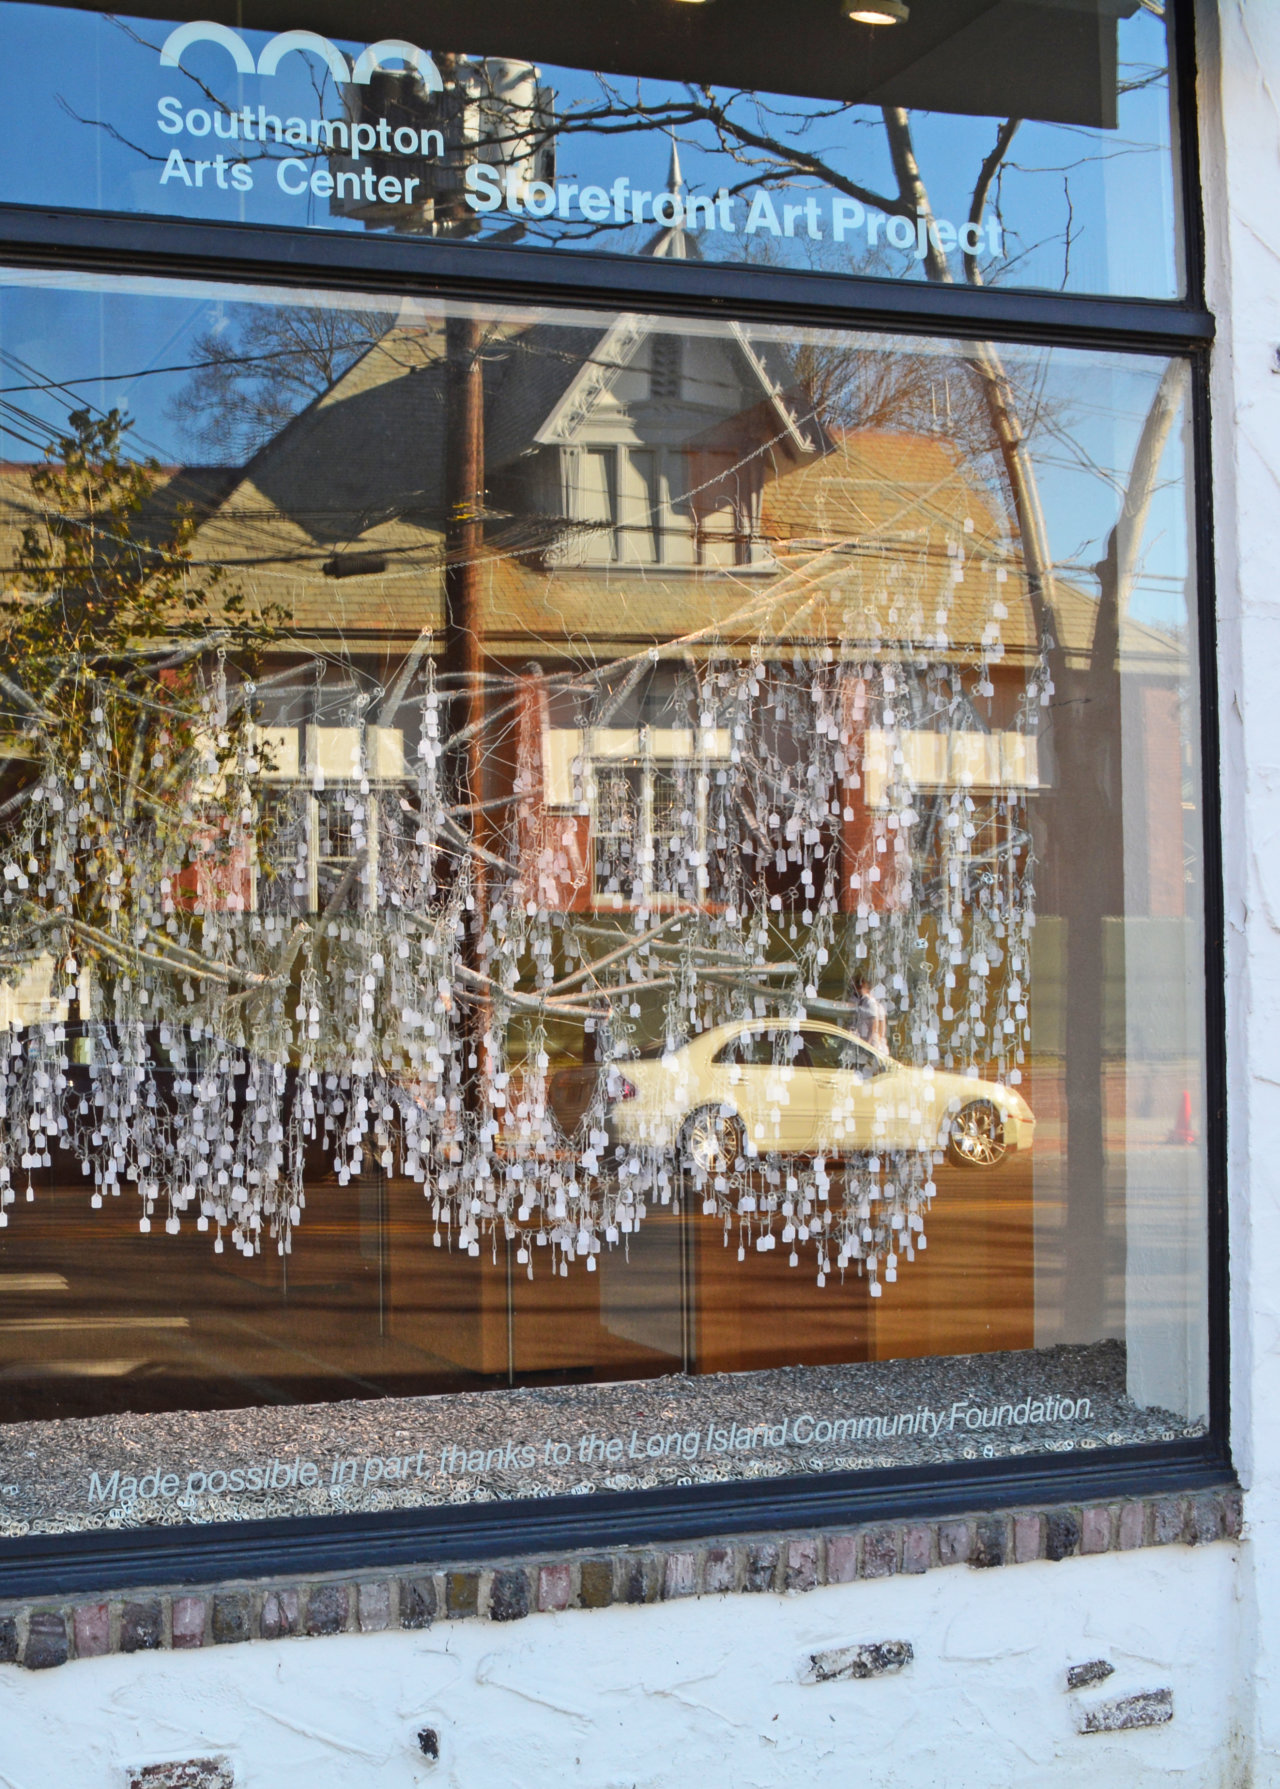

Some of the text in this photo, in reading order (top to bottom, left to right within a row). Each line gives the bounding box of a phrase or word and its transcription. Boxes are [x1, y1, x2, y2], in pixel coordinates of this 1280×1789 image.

[157, 96, 445, 159] Southampton
[159, 148, 420, 205] Arts Center
[464, 163, 1004, 260] Storefront Art Project
[86, 1469, 180, 1502] Made
[185, 1457, 325, 1497] possible,
[330, 1454, 358, 1484] in
[439, 1440, 536, 1474] thanks
[544, 1438, 572, 1466] to
[577, 1433, 624, 1464] the
[627, 1429, 700, 1461] Long
[706, 1417, 789, 1453] Island
[793, 1406, 945, 1446] Community
[950, 1394, 1096, 1431] Foundation.
